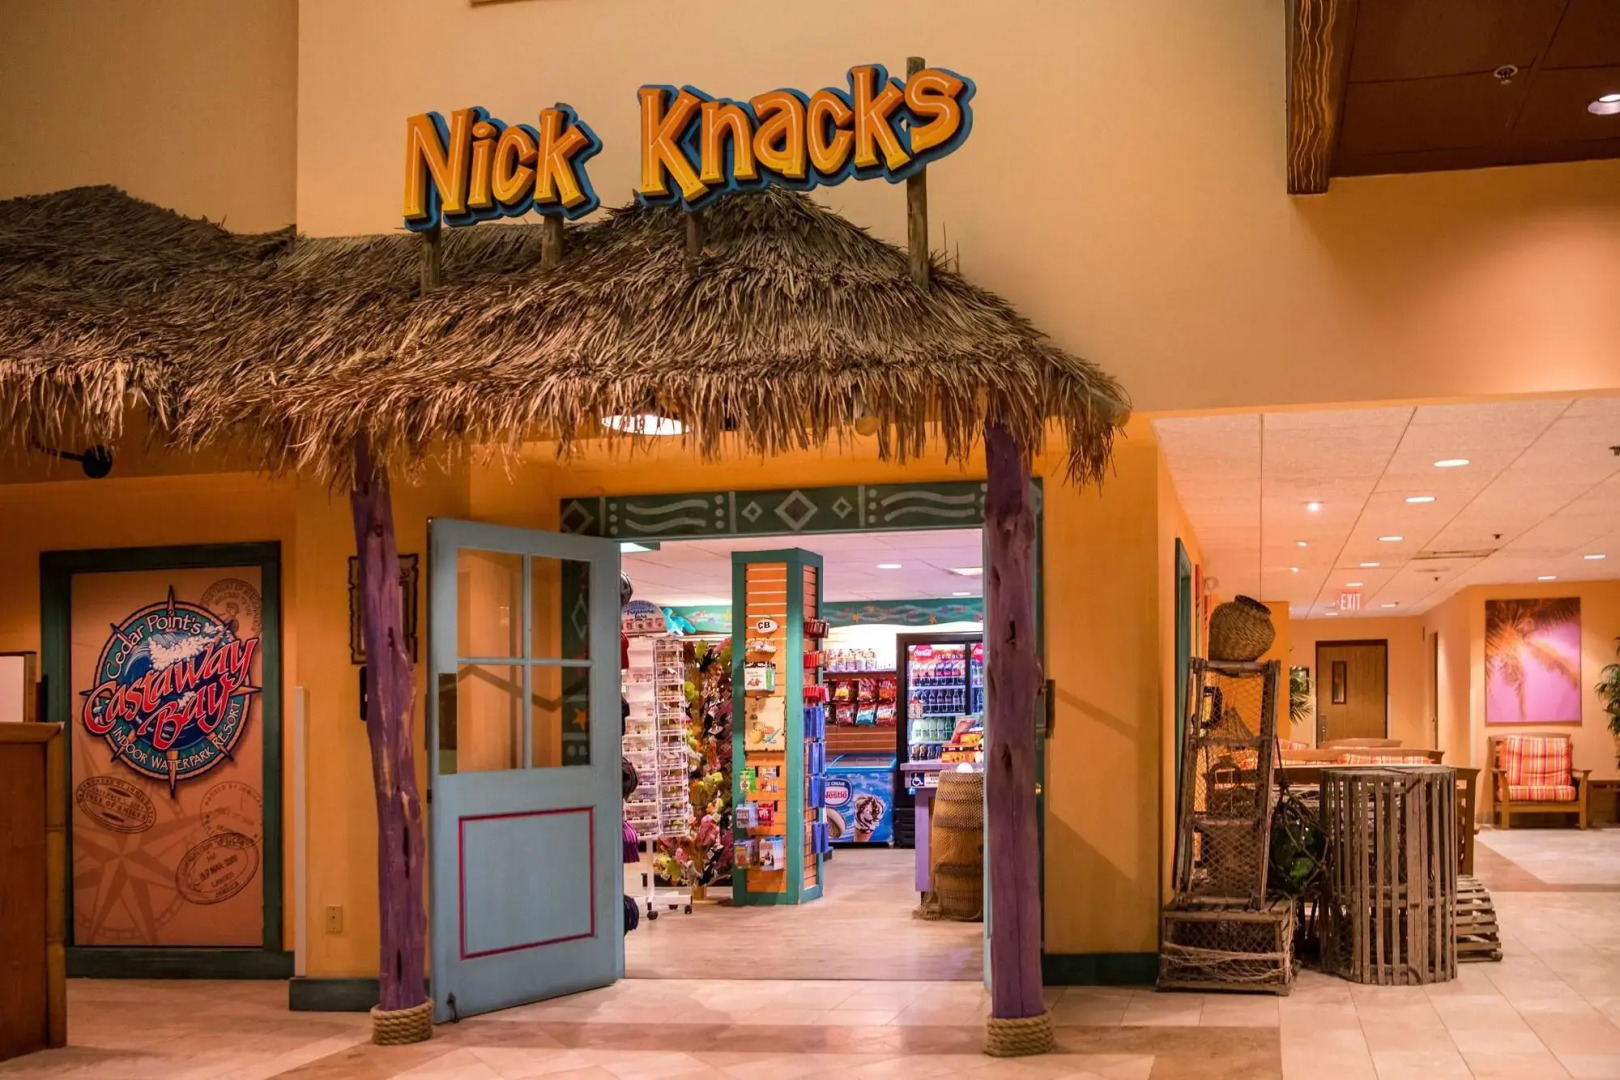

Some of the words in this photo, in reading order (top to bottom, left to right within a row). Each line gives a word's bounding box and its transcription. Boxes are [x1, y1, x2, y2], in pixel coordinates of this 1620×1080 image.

[403, 106, 591, 222] Nick
[638, 65, 967, 203] Knacks
[757, 621, 771, 630] CB
[1341, 593, 1360, 610] EXIT
[106, 625, 144, 679] Cedar
[146, 612, 202, 634] Point's
[84, 638, 259, 735] Castaway
[137, 673, 235, 750] Bay
[112, 726, 148, 764] INDOOR
[151, 746, 216, 771] WATERPARK
[212, 702, 241, 750] RESORT
